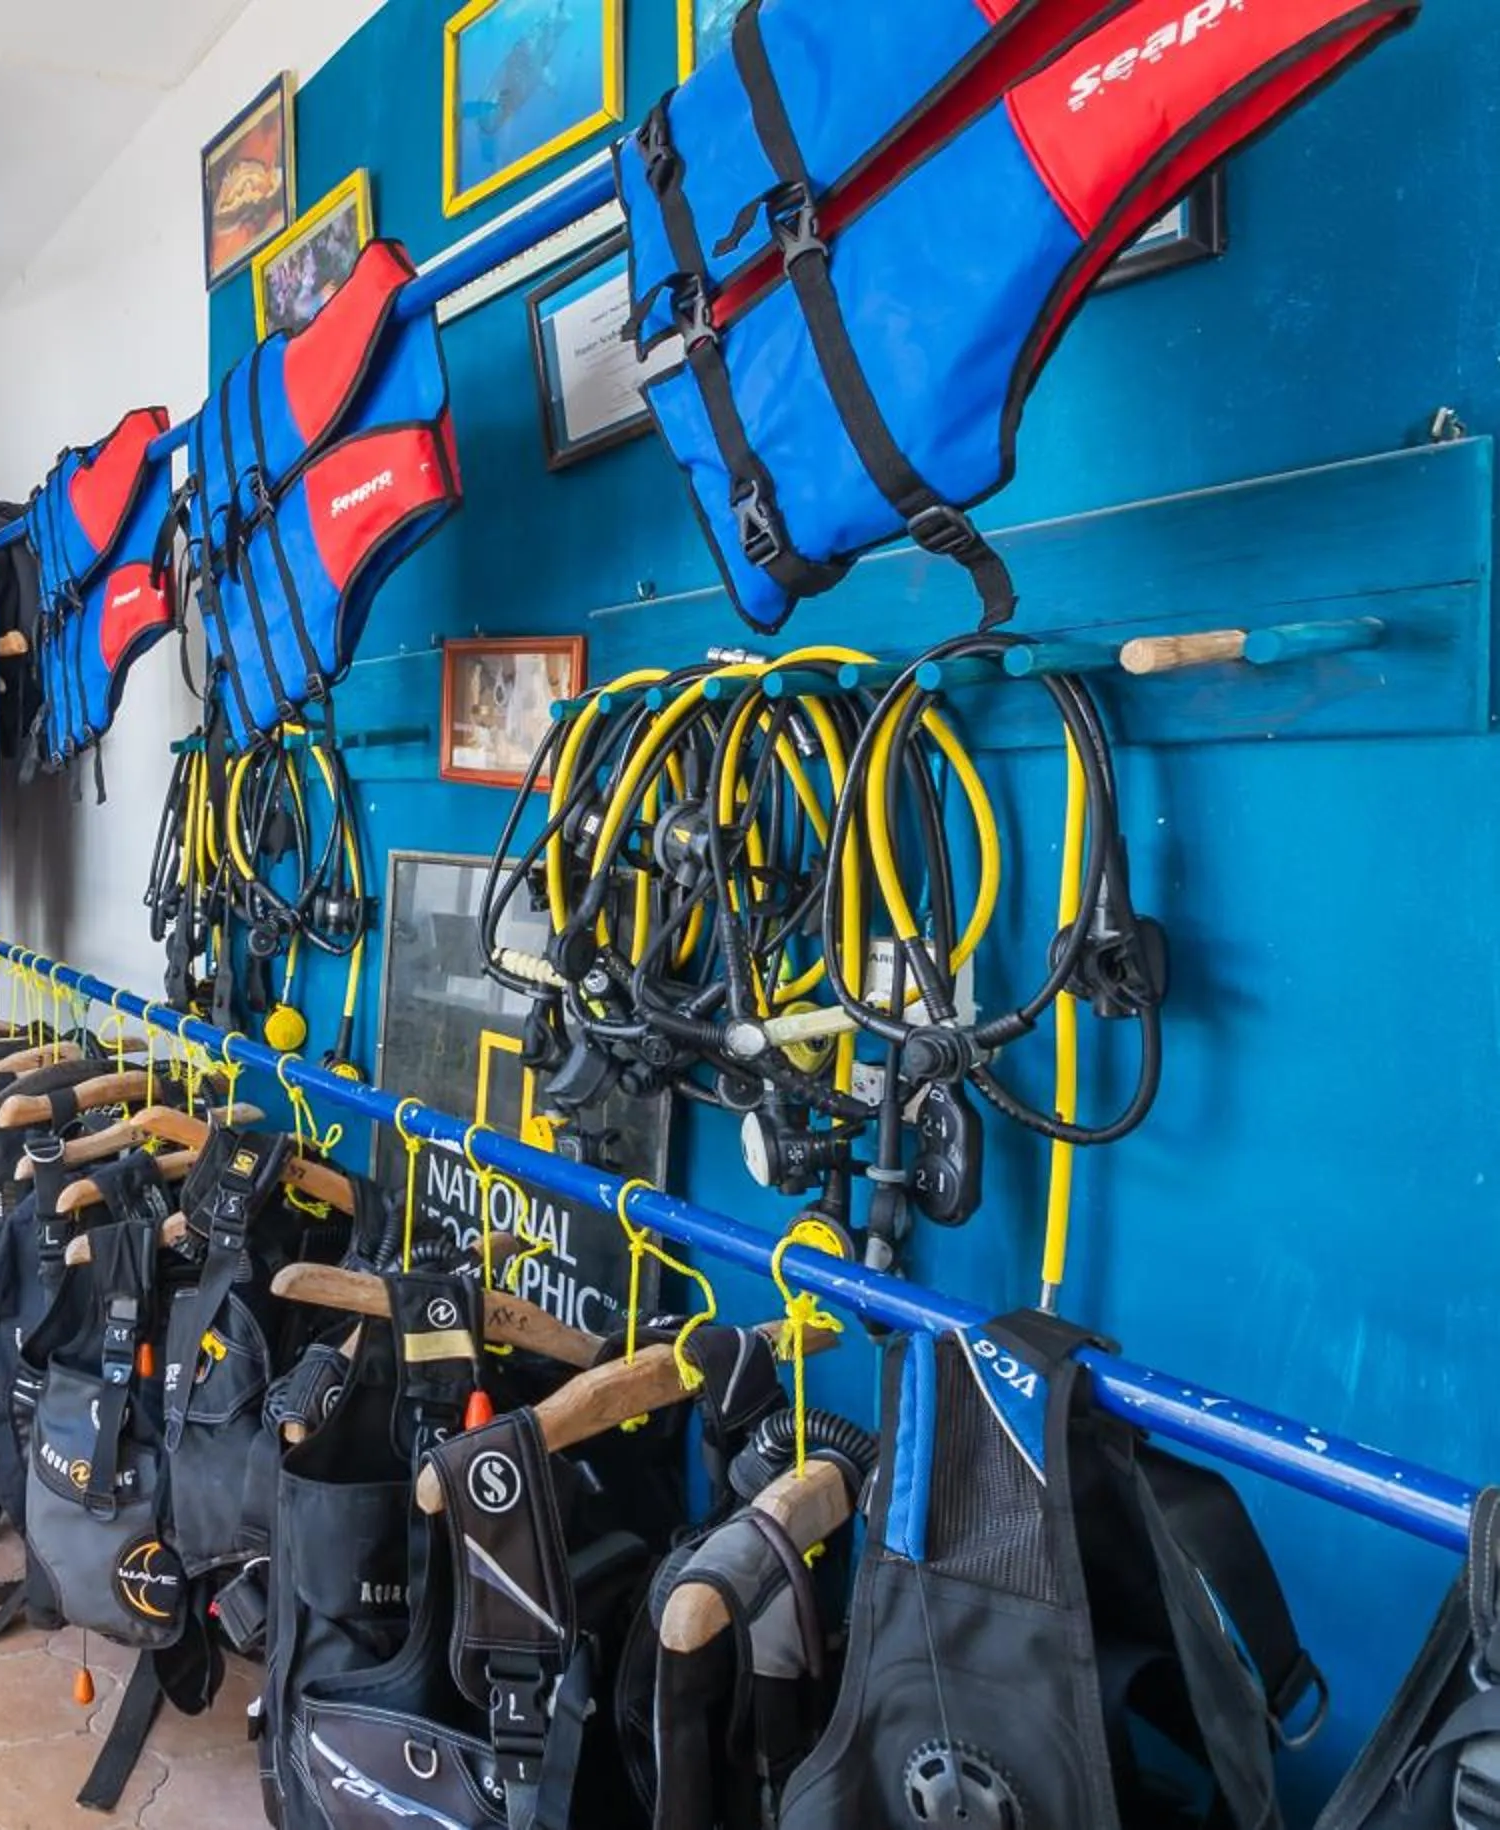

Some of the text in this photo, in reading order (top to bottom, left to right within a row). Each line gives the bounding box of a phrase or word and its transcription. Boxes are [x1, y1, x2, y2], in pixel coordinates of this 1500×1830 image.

[1067, 0, 1244, 113] Seap
[426, 1153, 578, 1266] NATONAL
[119, 1567, 179, 1585] WAVE
[509, 1692, 525, 1720] L
